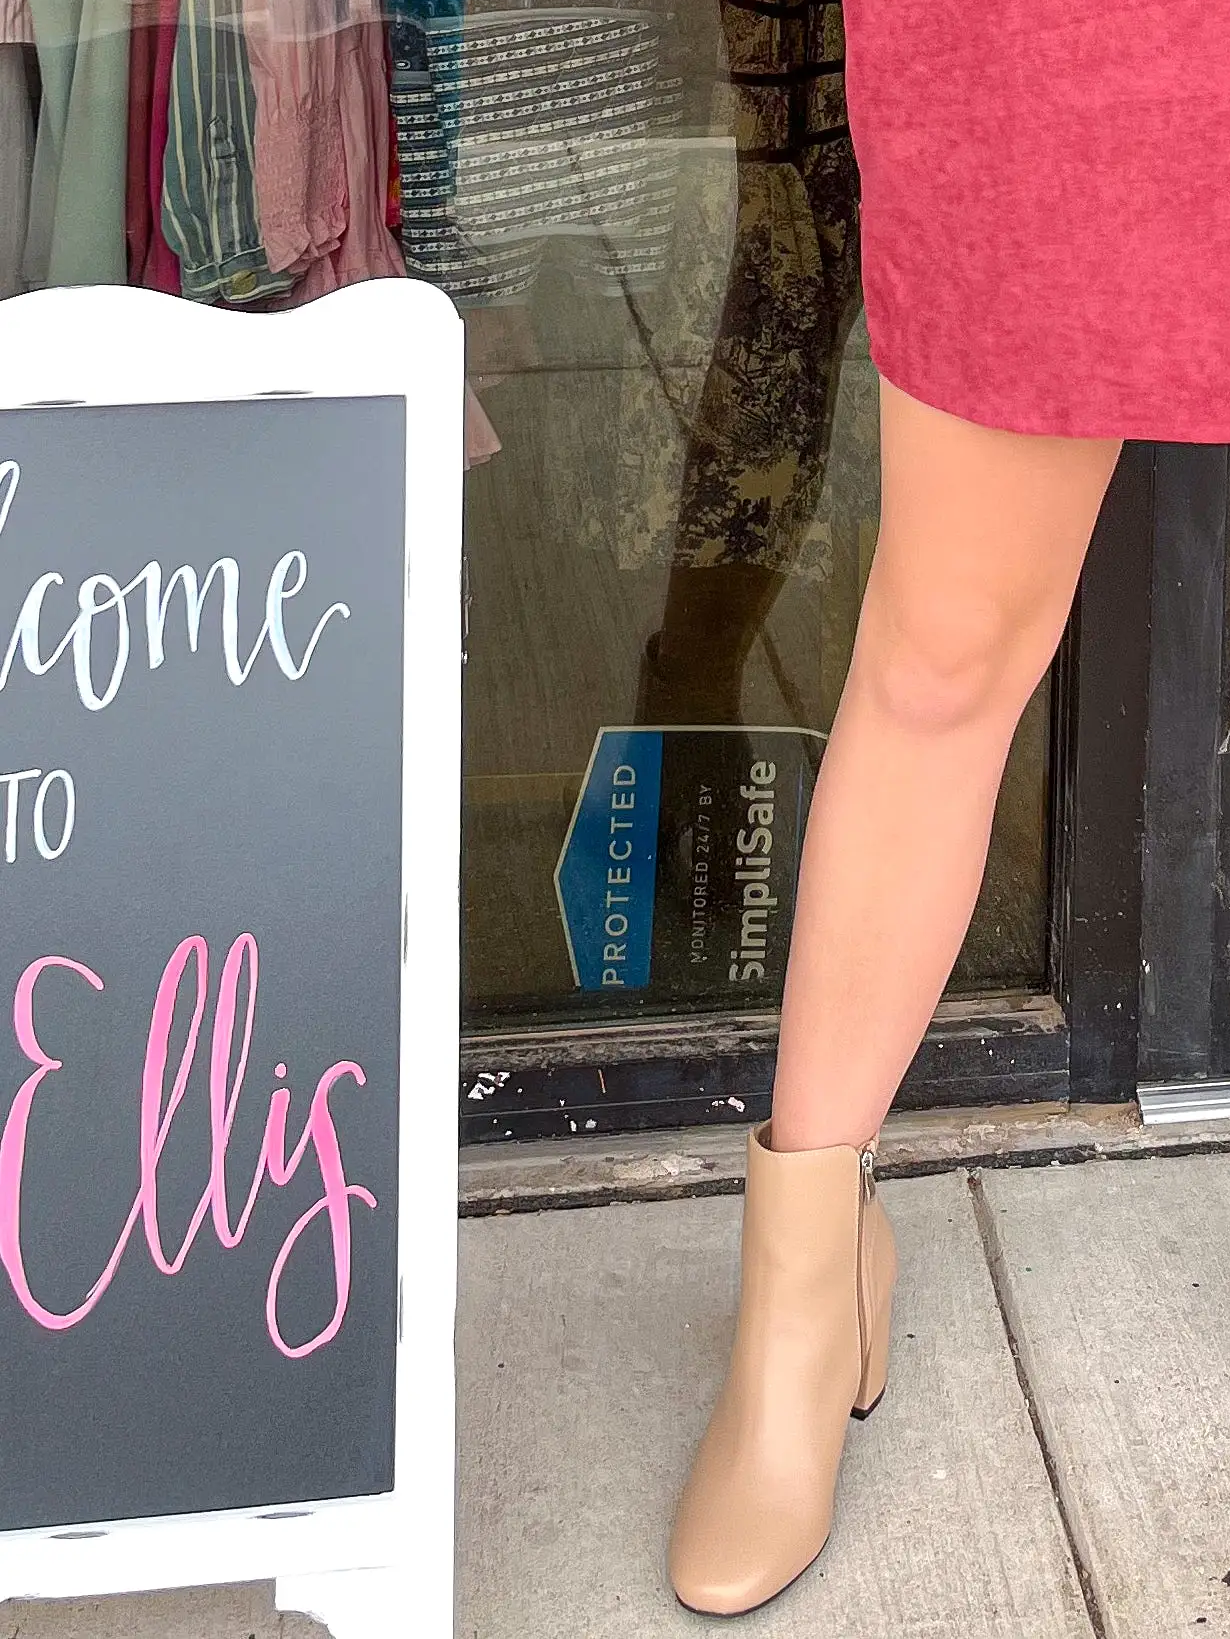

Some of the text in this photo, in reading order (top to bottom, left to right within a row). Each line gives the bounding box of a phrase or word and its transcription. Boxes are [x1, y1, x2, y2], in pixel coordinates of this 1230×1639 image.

[0, 769, 75, 863] TO
[602, 765, 636, 986] PROTECTED
[691, 784, 713, 963] MONITORED 24/7 BY
[729, 760, 777, 981] SimpliSafe
[0, 932, 377, 1358] Ellis
